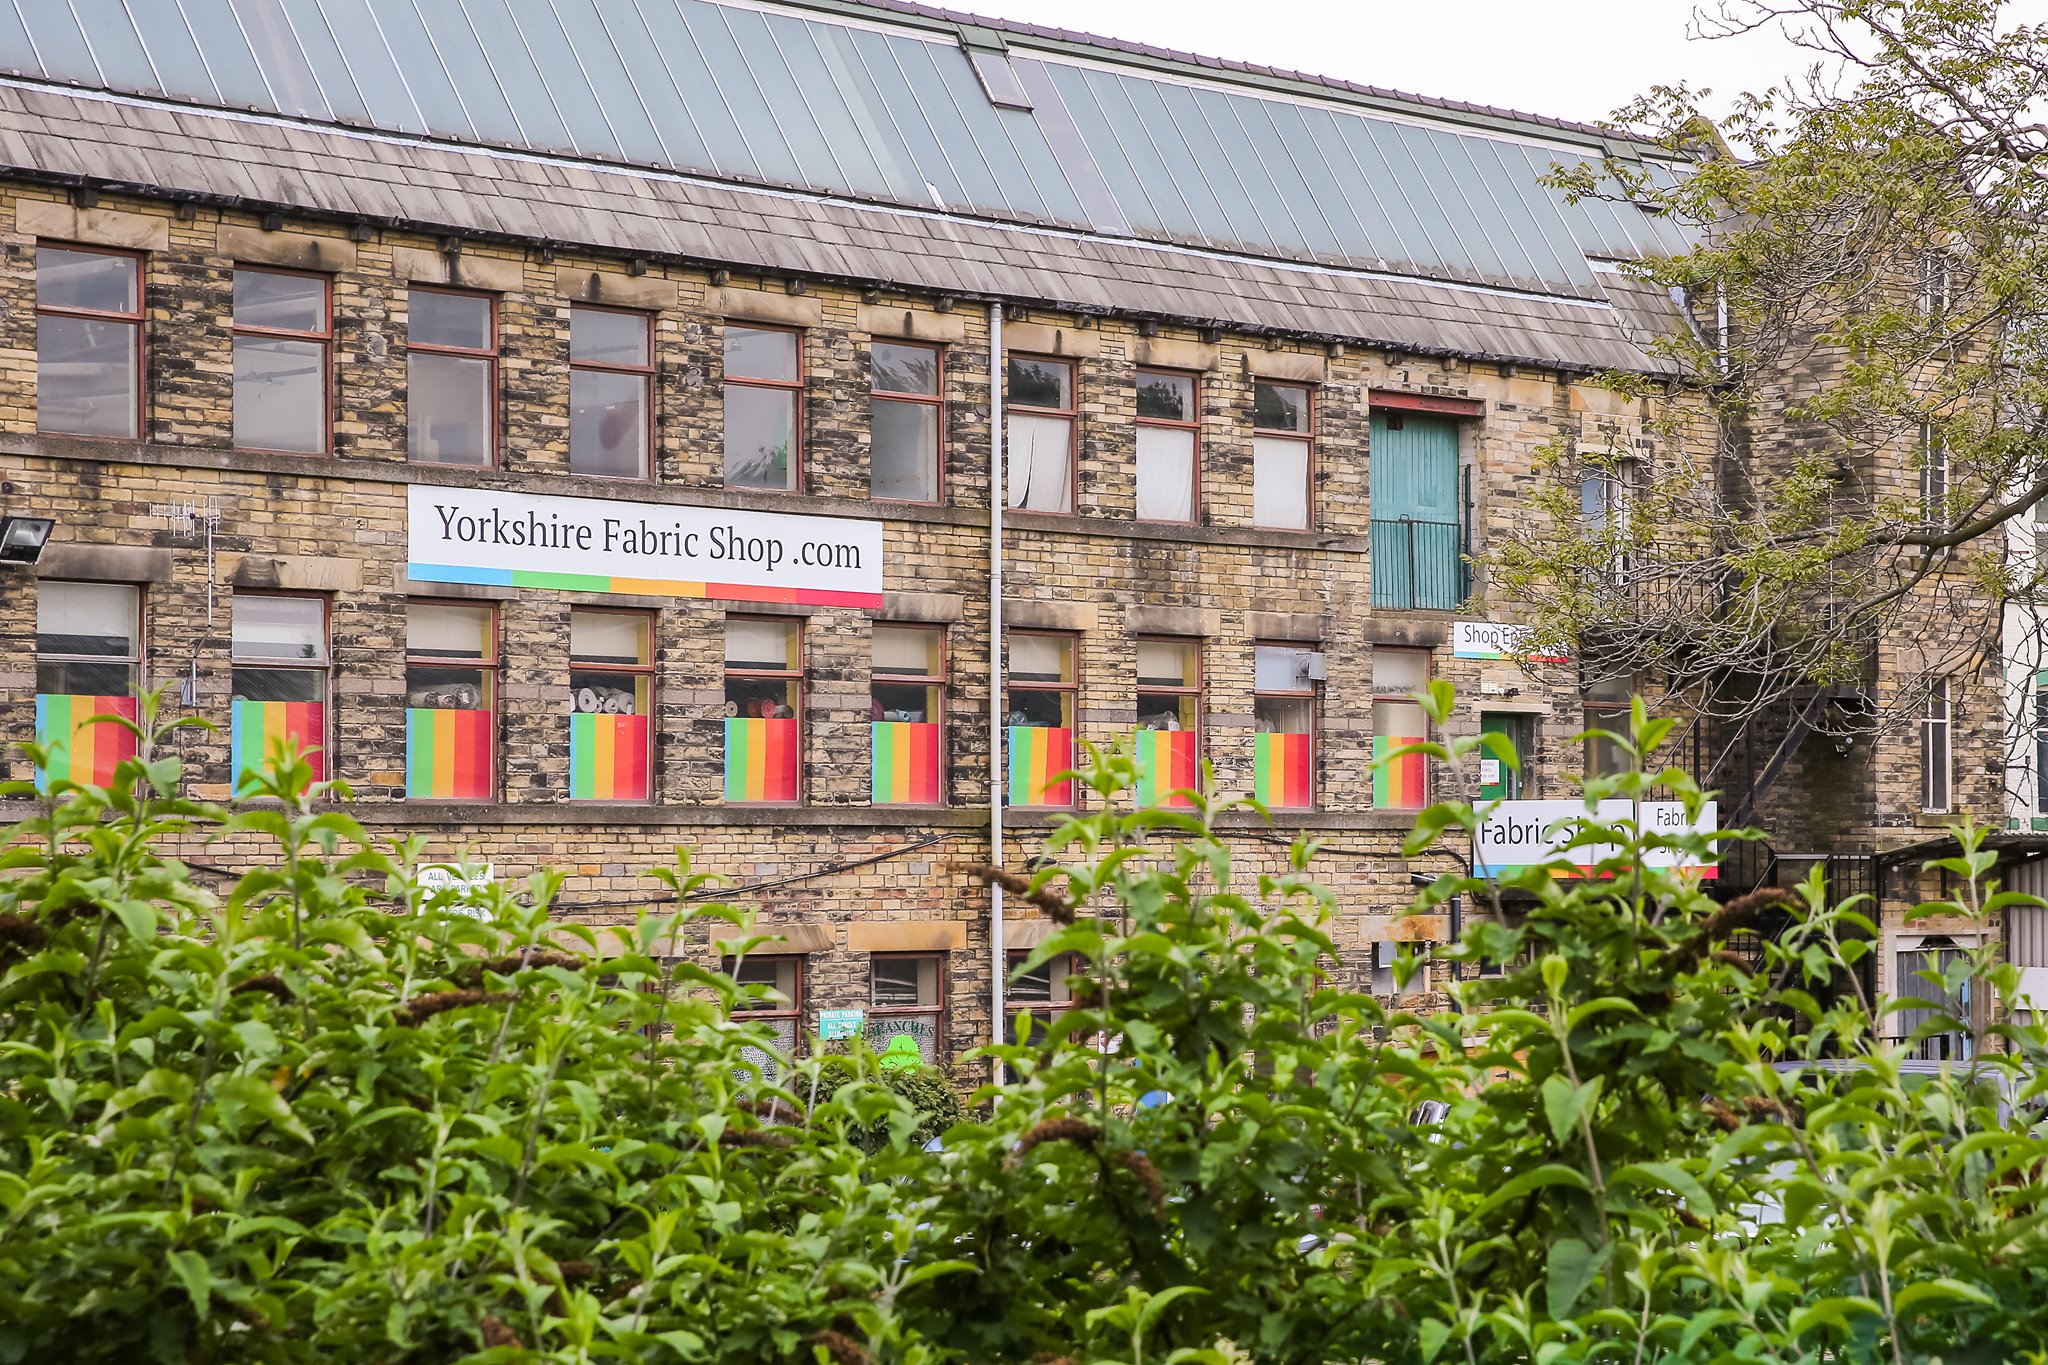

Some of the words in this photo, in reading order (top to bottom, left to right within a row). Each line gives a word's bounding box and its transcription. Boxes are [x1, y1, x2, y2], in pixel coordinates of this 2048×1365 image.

[435, 504, 592, 551] Yorkshire
[602, 518, 699, 558] Fabric
[709, 525, 783, 572] Shop
[793, 541, 862, 569] .com
[1464, 624, 1499, 648] Shop
[428, 872, 443, 881] ALL
[820, 1011, 840, 1019] PRIVATE
